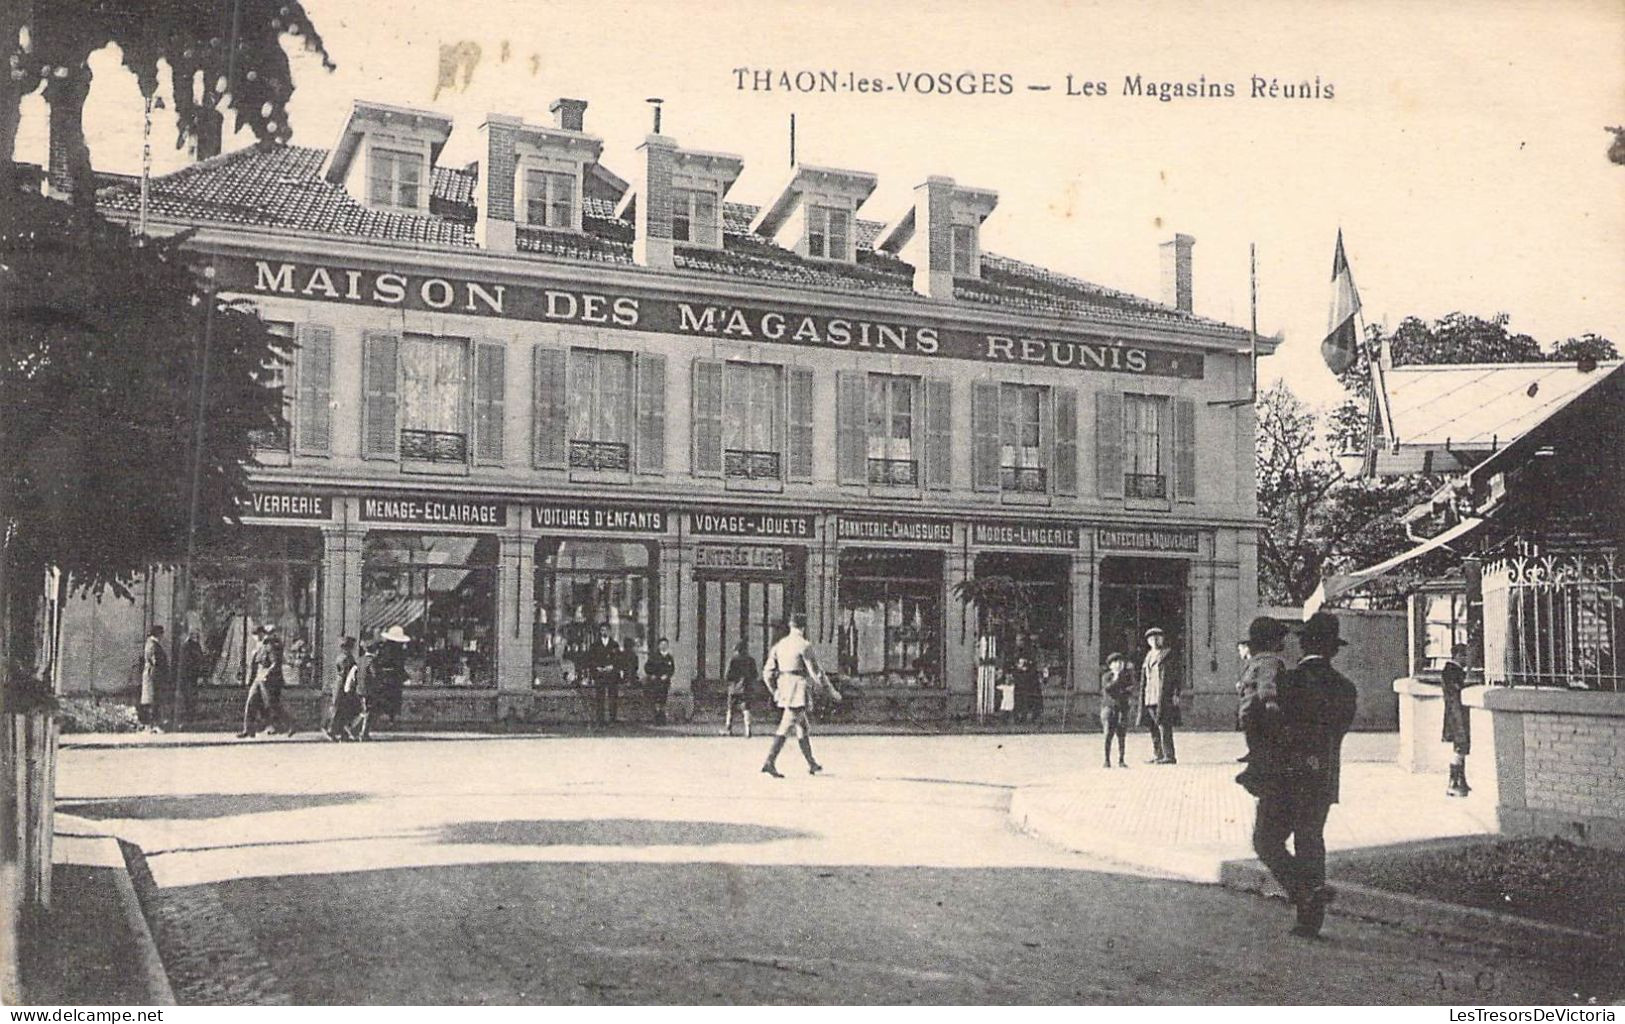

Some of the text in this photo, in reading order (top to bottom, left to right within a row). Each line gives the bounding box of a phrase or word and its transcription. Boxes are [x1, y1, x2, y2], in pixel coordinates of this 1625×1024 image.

[254, 260, 506, 313] MAISON
[544, 290, 640, 326] DES
[365, 499, 497, 523] MENAGE-ECLAIRAGE
[535, 507, 661, 530] VOITURES D'ENFANTS
